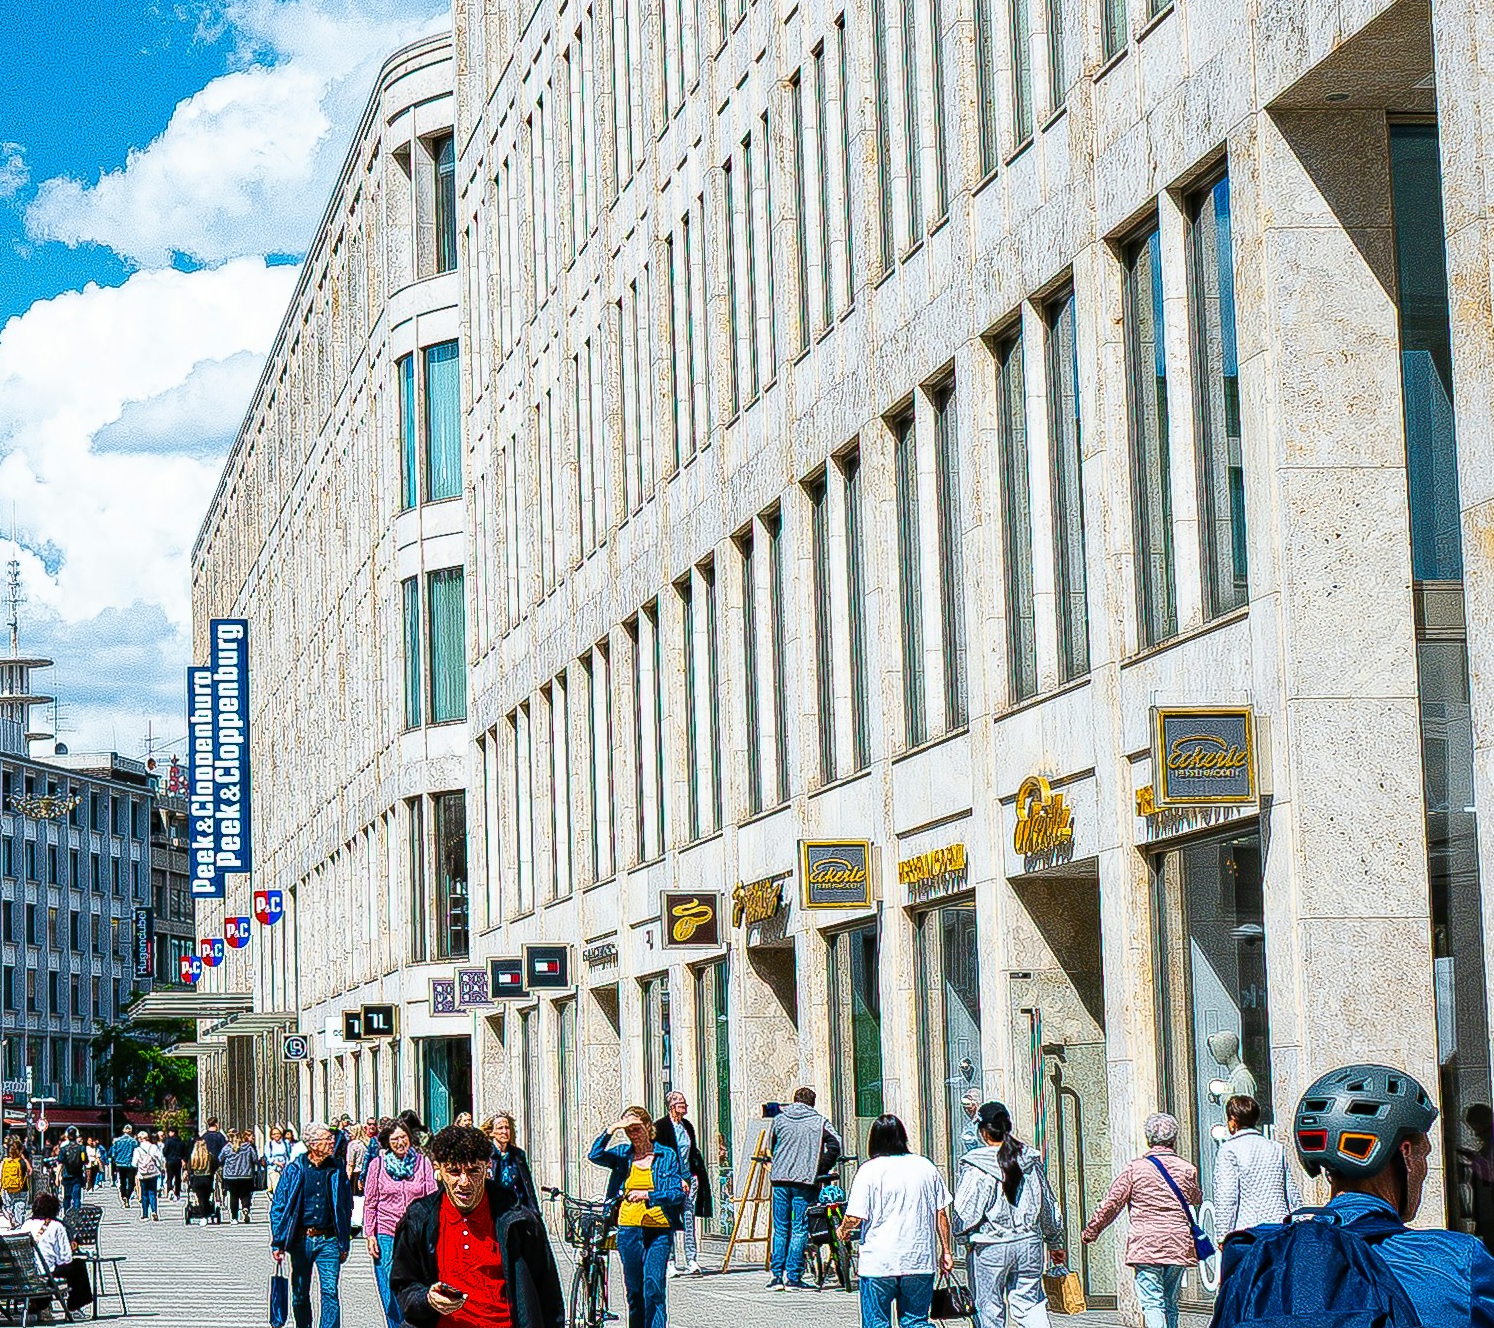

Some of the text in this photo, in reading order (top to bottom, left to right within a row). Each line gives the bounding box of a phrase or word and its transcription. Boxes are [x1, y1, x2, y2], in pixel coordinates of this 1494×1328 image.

[1167, 734, 1248, 769] Eckerle
[809, 858, 866, 883] Eckerle
[255, 896, 281, 914] P&C
[225, 922, 249, 939] P&C
[201, 943, 223, 958] P&C
[181, 961, 201, 975] P&C
